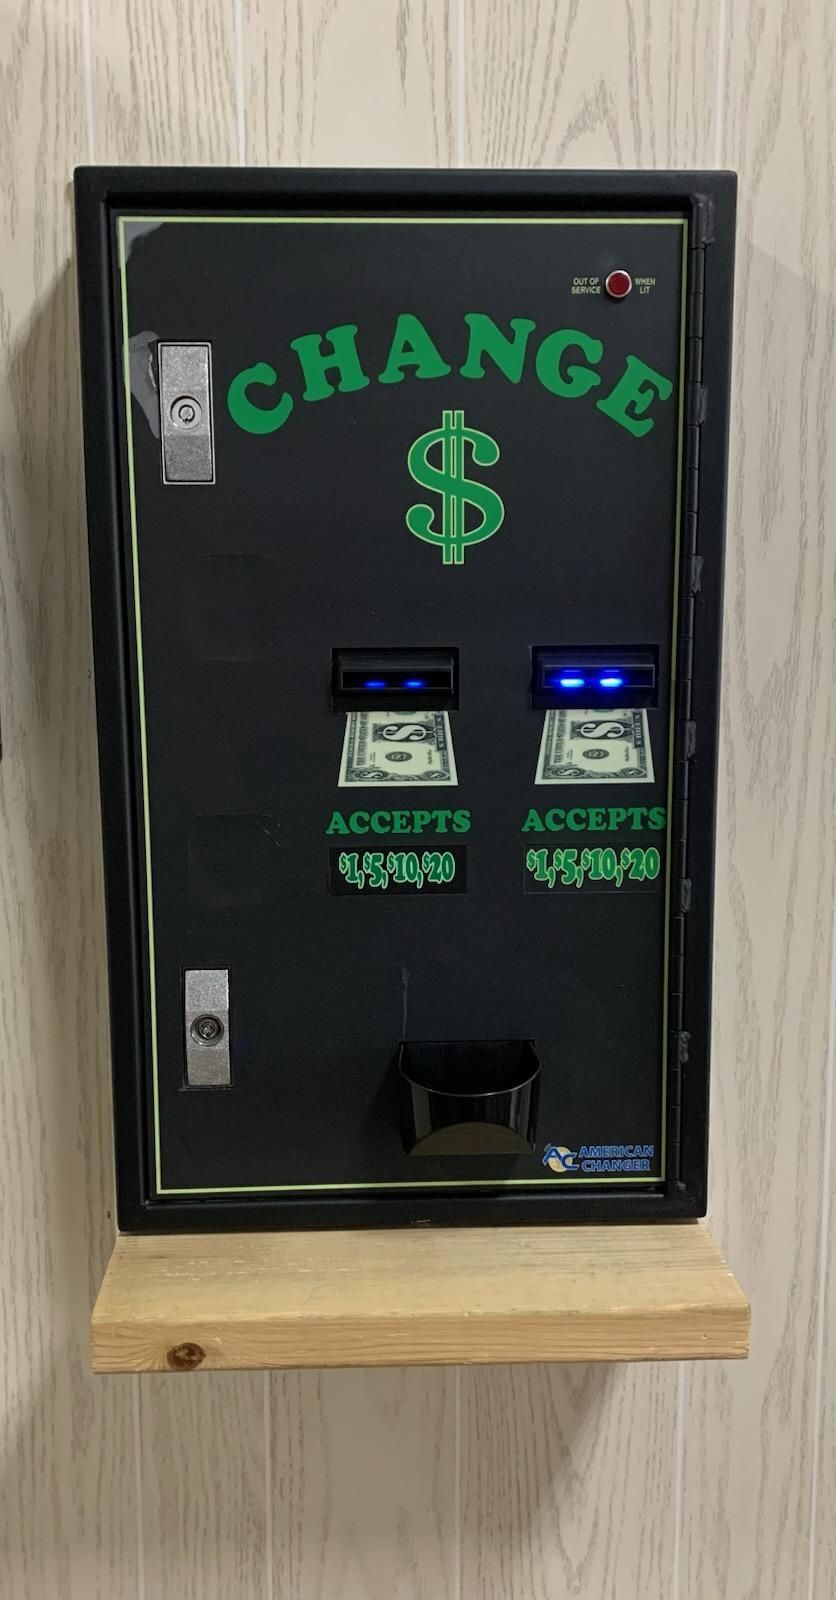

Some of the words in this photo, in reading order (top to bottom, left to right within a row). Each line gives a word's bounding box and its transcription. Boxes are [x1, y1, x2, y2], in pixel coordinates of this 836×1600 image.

[573, 277, 588, 286] OUT
[589, 277, 600, 286] OF
[634, 277, 656, 286] WHEN
[571, 286, 601, 295] SERVICE
[640, 286, 651, 294] LIT
[227, 312, 674, 438] CHANGE
[405, 409, 505, 565] $
[325, 809, 471, 835] ACCEPTS
[521, 806, 666, 832] ACCEPTS
[578, 1145, 654, 1158] AMERICAN
[581, 1159, 651, 1173] CHANGER
